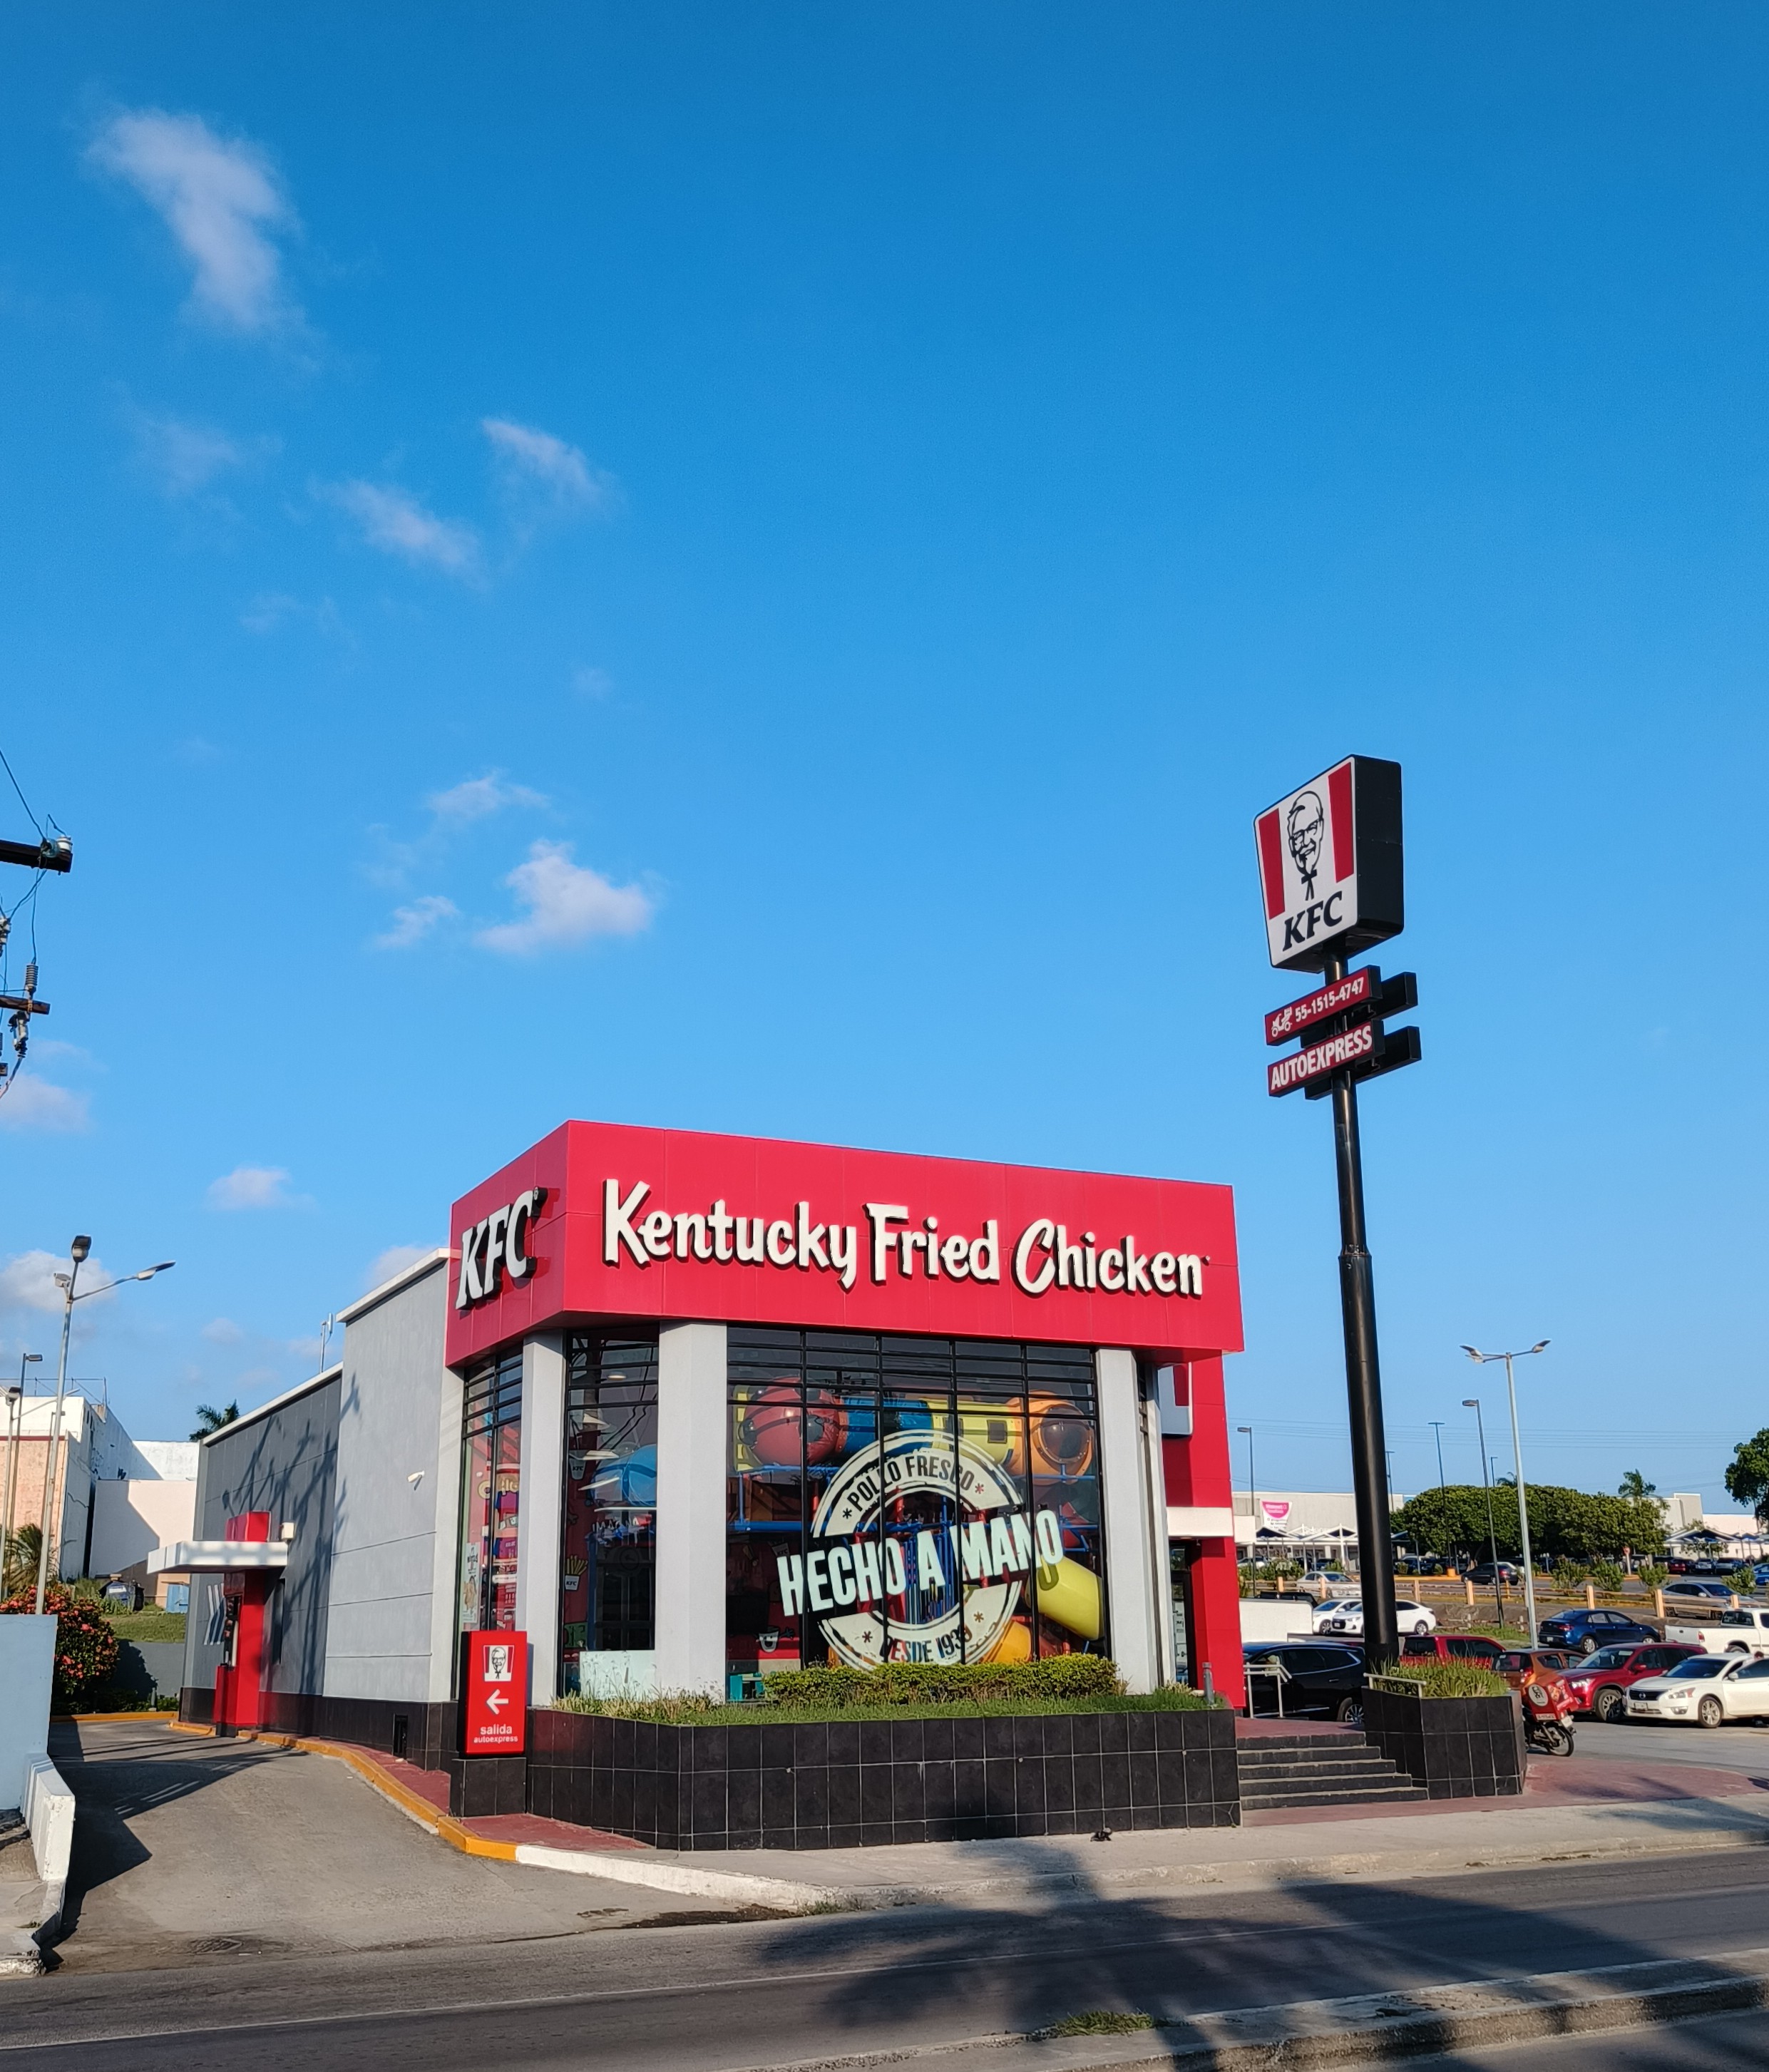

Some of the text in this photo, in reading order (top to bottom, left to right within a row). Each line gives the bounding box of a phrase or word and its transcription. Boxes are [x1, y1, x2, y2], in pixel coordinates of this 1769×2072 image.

[1282, 891, 1343, 952] KFC
[1294, 976, 1365, 1022] 55-1515-4747
[1271, 1025, 1373, 1090] AUTOEXPRESS
[455, 1189, 535, 1311] KFC
[603, 1178, 1204, 1296] Kentucky Fried Chicken
[905, 1455, 975, 1492] FRESCO
[776, 1509, 1064, 1617] HECHO A MANO
[473, 1735, 518, 1744] autoexpress
[480, 1723, 513, 1735] salida
